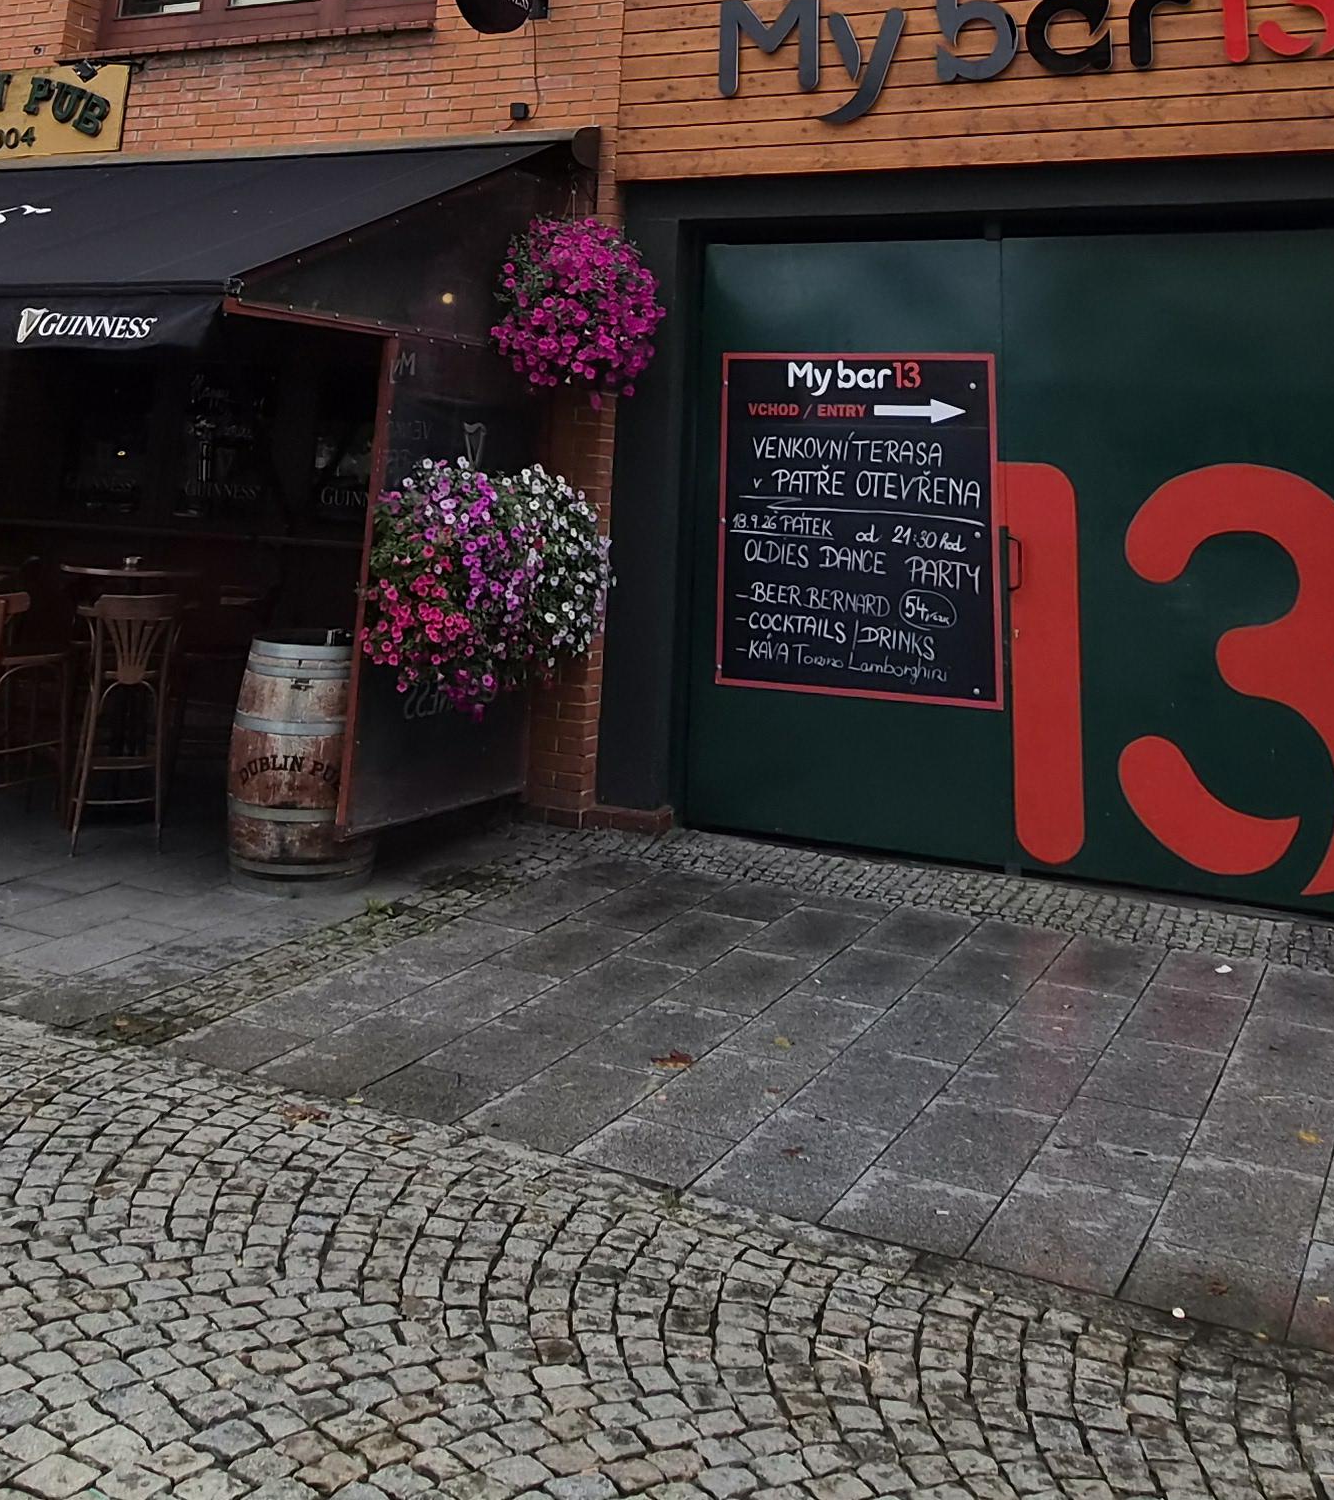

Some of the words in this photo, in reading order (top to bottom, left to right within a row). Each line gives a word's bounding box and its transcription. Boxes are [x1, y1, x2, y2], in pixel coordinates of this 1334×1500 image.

[23, 76, 110, 138] PUB
[36, 312, 154, 341] GUINNESS
[787, 361, 832, 397] My
[747, 402, 800, 417] VCHOD
[817, 403, 867, 418] ENTRY
[752, 431, 855, 461] VENKOVNÍ
[851, 440, 943, 467] TERASA
[771, 464, 846, 496] PATŘE
[855, 469, 981, 509] OTEVŘENA
[779, 511, 833, 537] PÁTEK
[855, 524, 881, 543] od
[891, 525, 938, 549] 21:30
[744, 538, 809, 569] OLDIES
[818, 545, 887, 575] DANCE
[904, 555, 981, 594] PARTY
[749, 581, 802, 607] BEER
[803, 587, 891, 618] BERNARD
[748, 611, 847, 644] COCKTAILS
[857, 626, 935, 662] DRINKS
[748, 633, 789, 664] KÁVA
[847, 651, 947, 685] Lamborghini
[239, 754, 306, 788] DUBLIN
